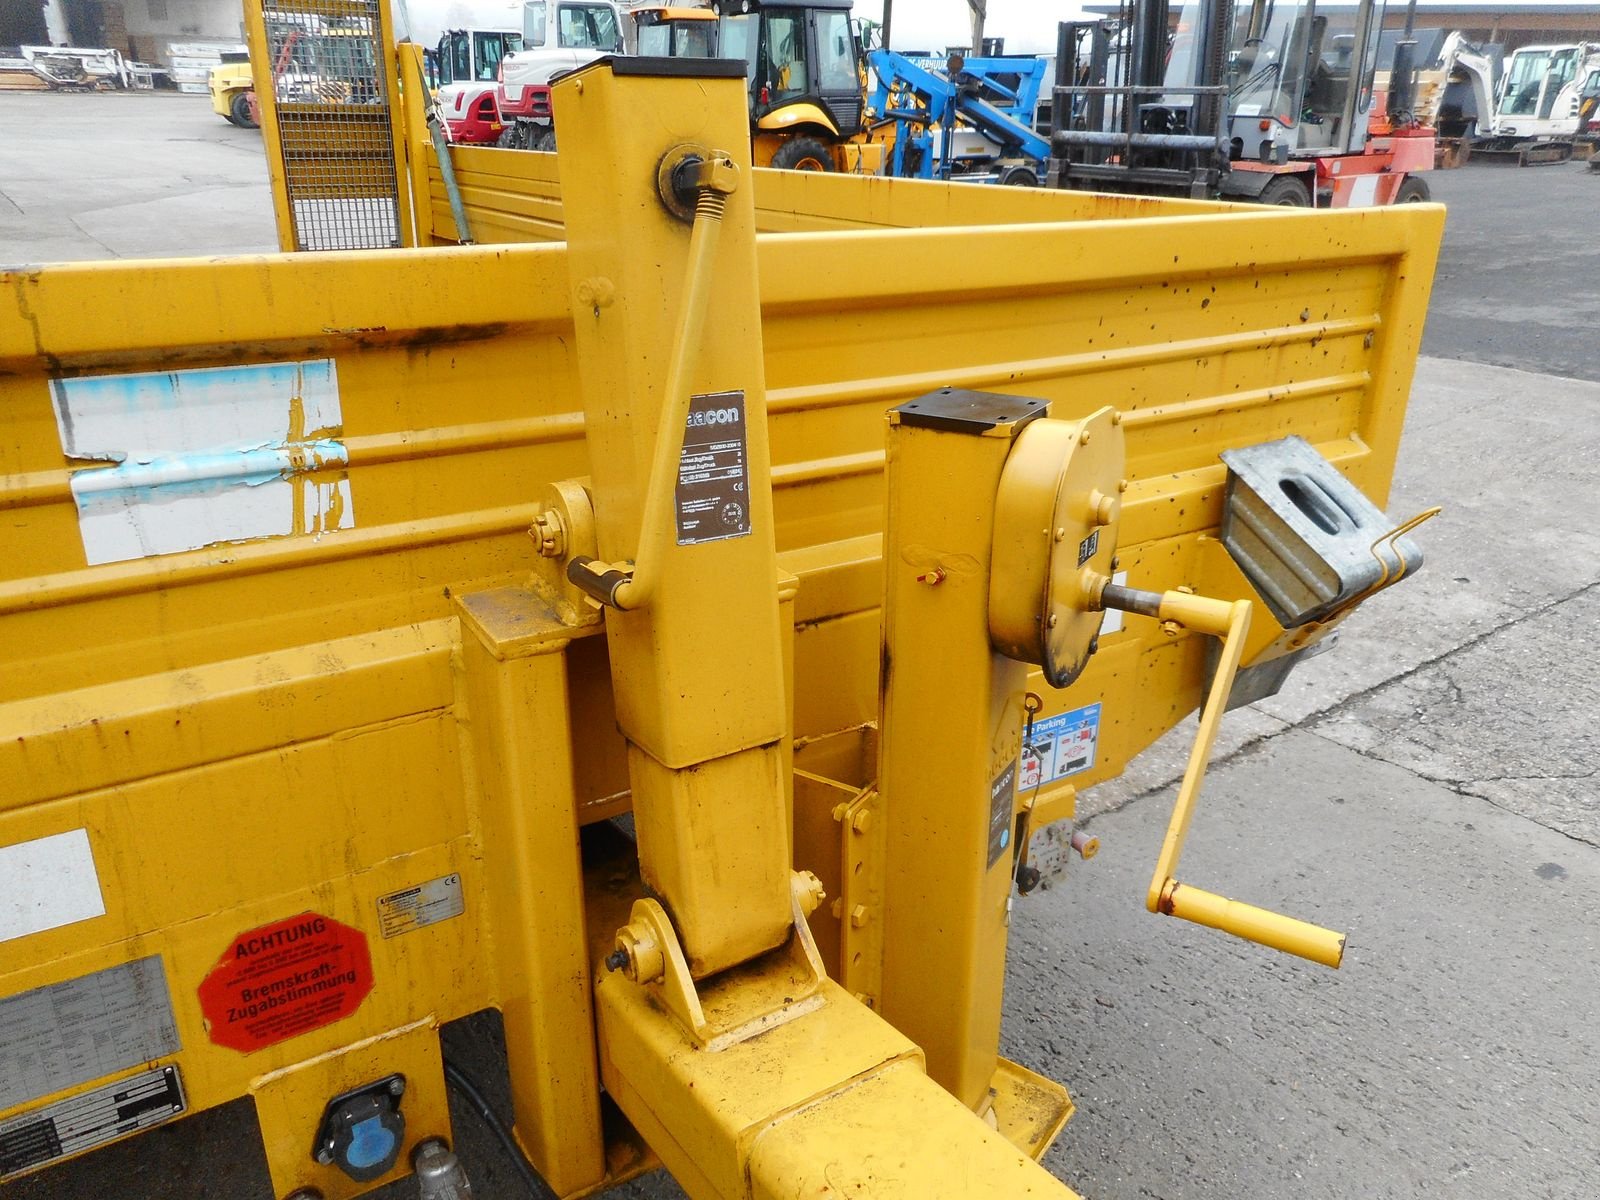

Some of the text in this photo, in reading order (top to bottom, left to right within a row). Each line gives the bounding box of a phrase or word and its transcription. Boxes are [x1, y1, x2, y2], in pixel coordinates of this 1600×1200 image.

[1036, 717, 1066, 733] Parking
[235, 917, 327, 960] ACHTUNG
[226, 969, 357, 1024] Zugabstimmung
[240, 963, 338, 1004] Bremskraft-
